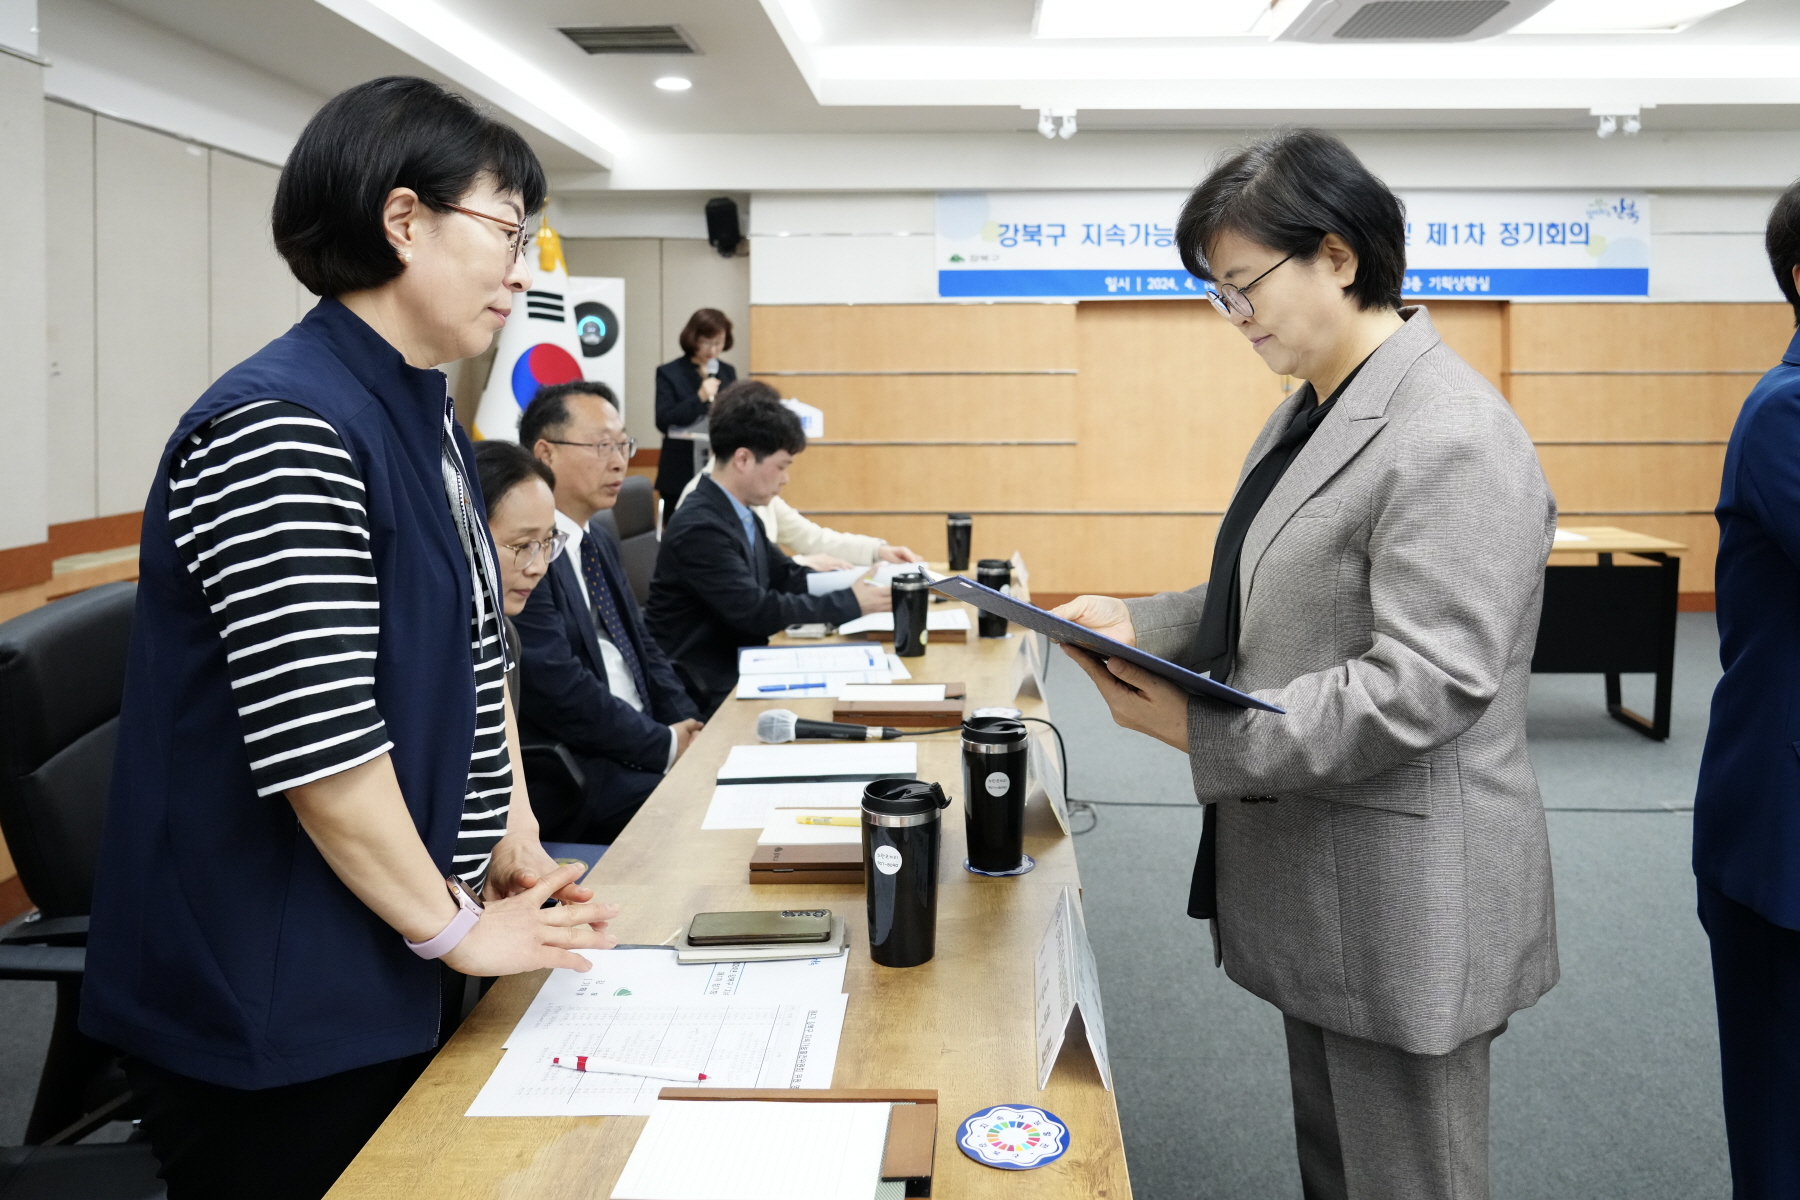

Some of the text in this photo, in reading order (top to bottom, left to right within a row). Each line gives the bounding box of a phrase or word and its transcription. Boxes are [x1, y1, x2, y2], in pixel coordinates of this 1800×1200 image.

[998, 222, 1067, 248] 강북구
[1426, 222, 1485, 246] 제1차
[1500, 222, 1590, 247] 정기회의
[1104, 276, 1131, 292] 일시
[1428, 275, 1490, 292] 기획상황실
